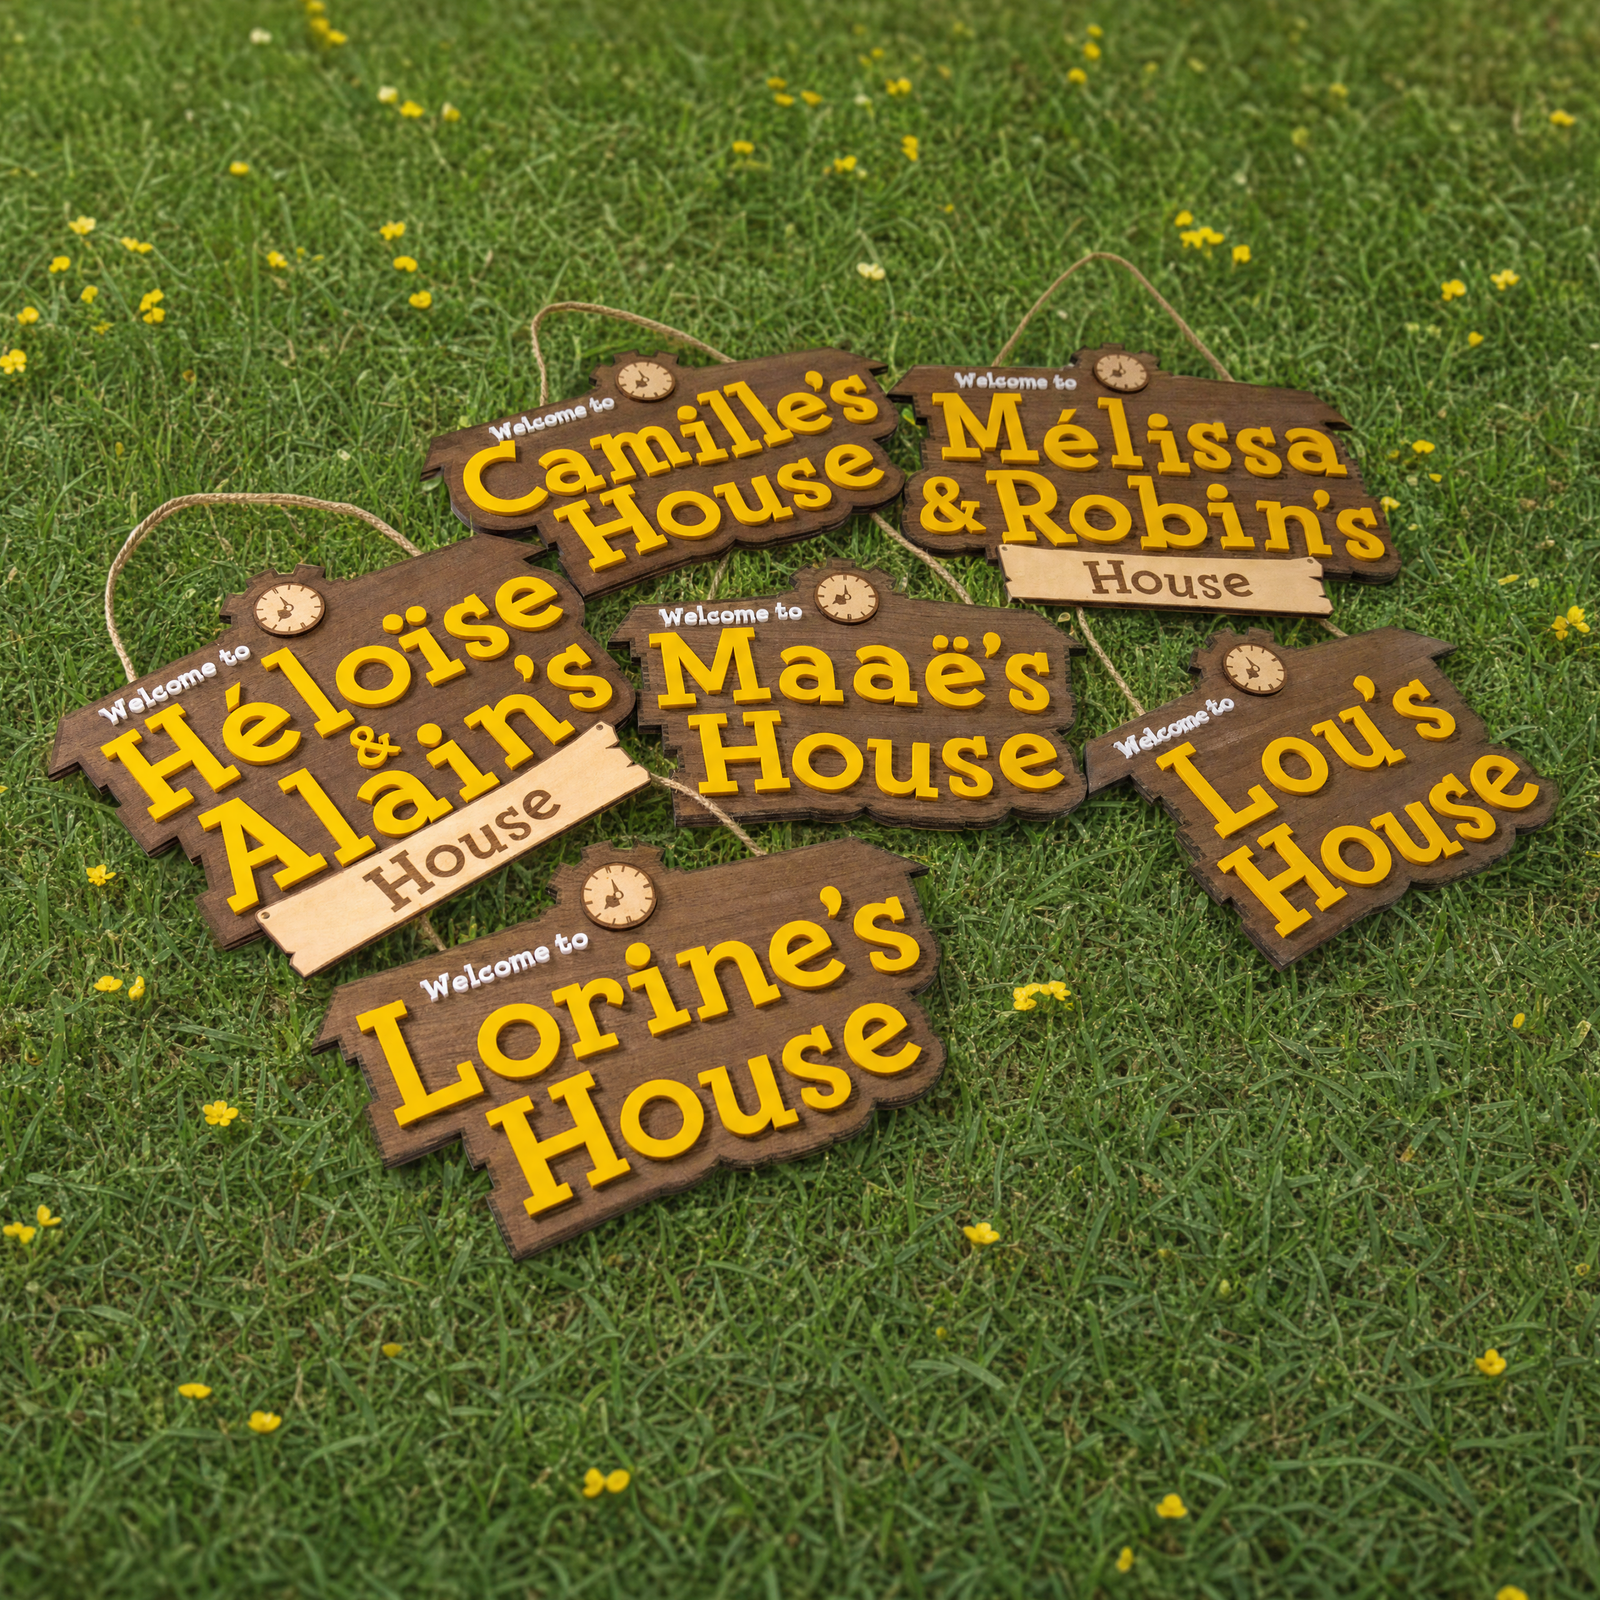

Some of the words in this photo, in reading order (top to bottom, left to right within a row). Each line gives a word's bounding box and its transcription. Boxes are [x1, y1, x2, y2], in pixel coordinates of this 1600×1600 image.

[488, 402, 588, 442] Welcome
[588, 396, 615, 414] to
[954, 371, 1048, 390] Welcome
[1053, 373, 1078, 391] to
[463, 370, 879, 517] Camille's
[932, 392, 1348, 478] Mélissa
[553, 443, 885, 573] House
[920, 476, 987, 536] &
[985, 469, 1386, 562] Robin's
[659, 603, 769, 627] Welcome
[774, 602, 803, 621] to
[1083, 560, 1253, 600] House
[98, 656, 217, 726] Welcome
[219, 643, 251, 667] to
[101, 575, 566, 823] Héloïse
[648, 626, 1051, 715] Maaë's
[198, 643, 613, 916] Alain's
[349, 725, 401, 769] &
[687, 709, 1065, 801] House
[1155, 675, 1457, 840] Lou's
[362, 788, 561, 913] House
[1217, 754, 1540, 939] House
[355, 885, 921, 1129] Lorine's
[419, 946, 550, 1002] Welcome
[554, 931, 589, 954] to
[485, 1002, 923, 1219] House
